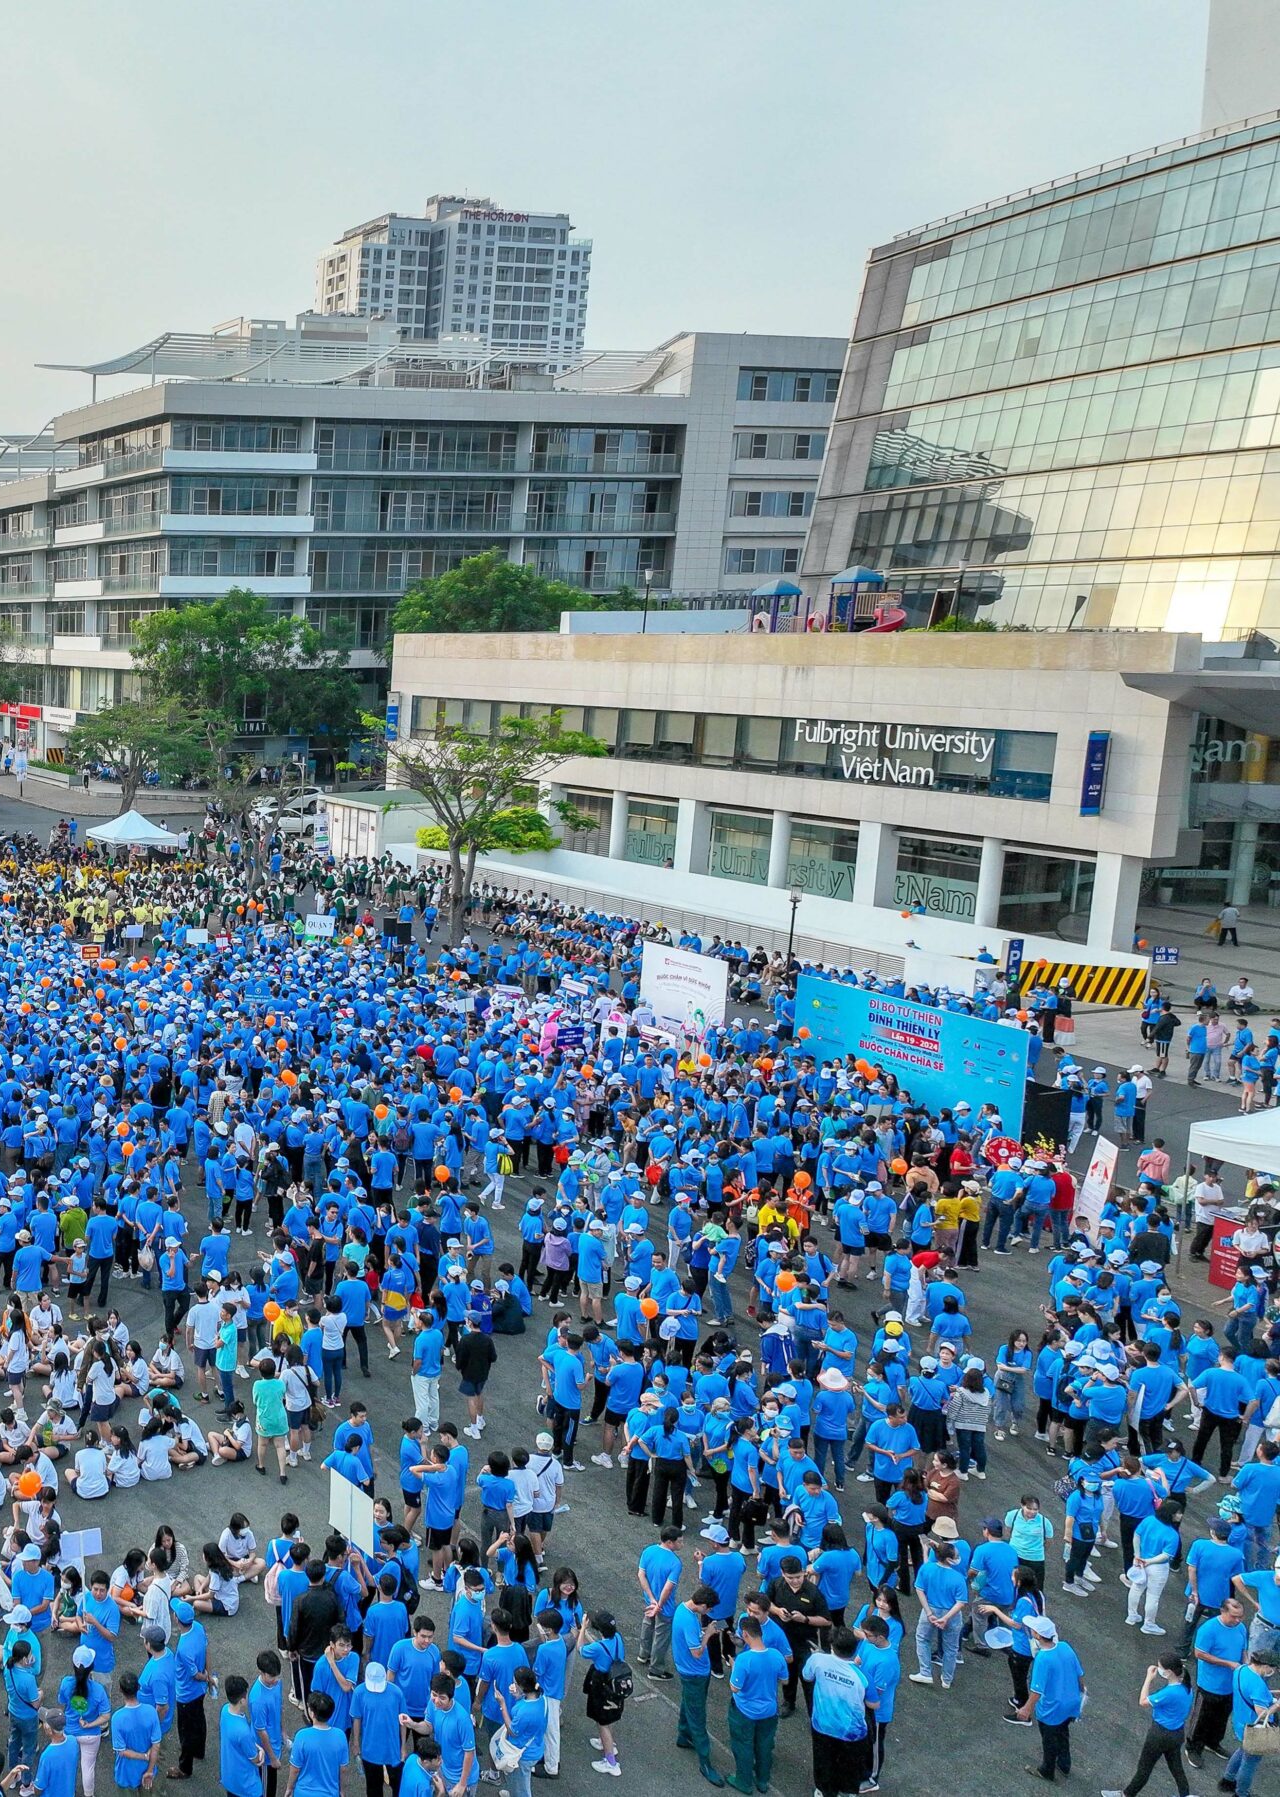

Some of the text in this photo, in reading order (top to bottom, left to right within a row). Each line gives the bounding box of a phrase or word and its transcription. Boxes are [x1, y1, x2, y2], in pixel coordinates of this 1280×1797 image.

[464, 209, 529, 223] THE HORIZON
[794, 719, 995, 762] Fulbright University
[1009, 950, 1021, 965] P
[882, 1002, 895, 1016] BỘ
[912, 1009, 942, 1027] THIỆN
[896, 1019, 925, 1037] THIỆN
[892, 1032, 938, 1051] Lần 19 2024
[859, 1040, 883, 1053] BƯỚC
[884, 1047, 909, 1061] CHÂN
[910, 1054, 932, 1068] CHIA
